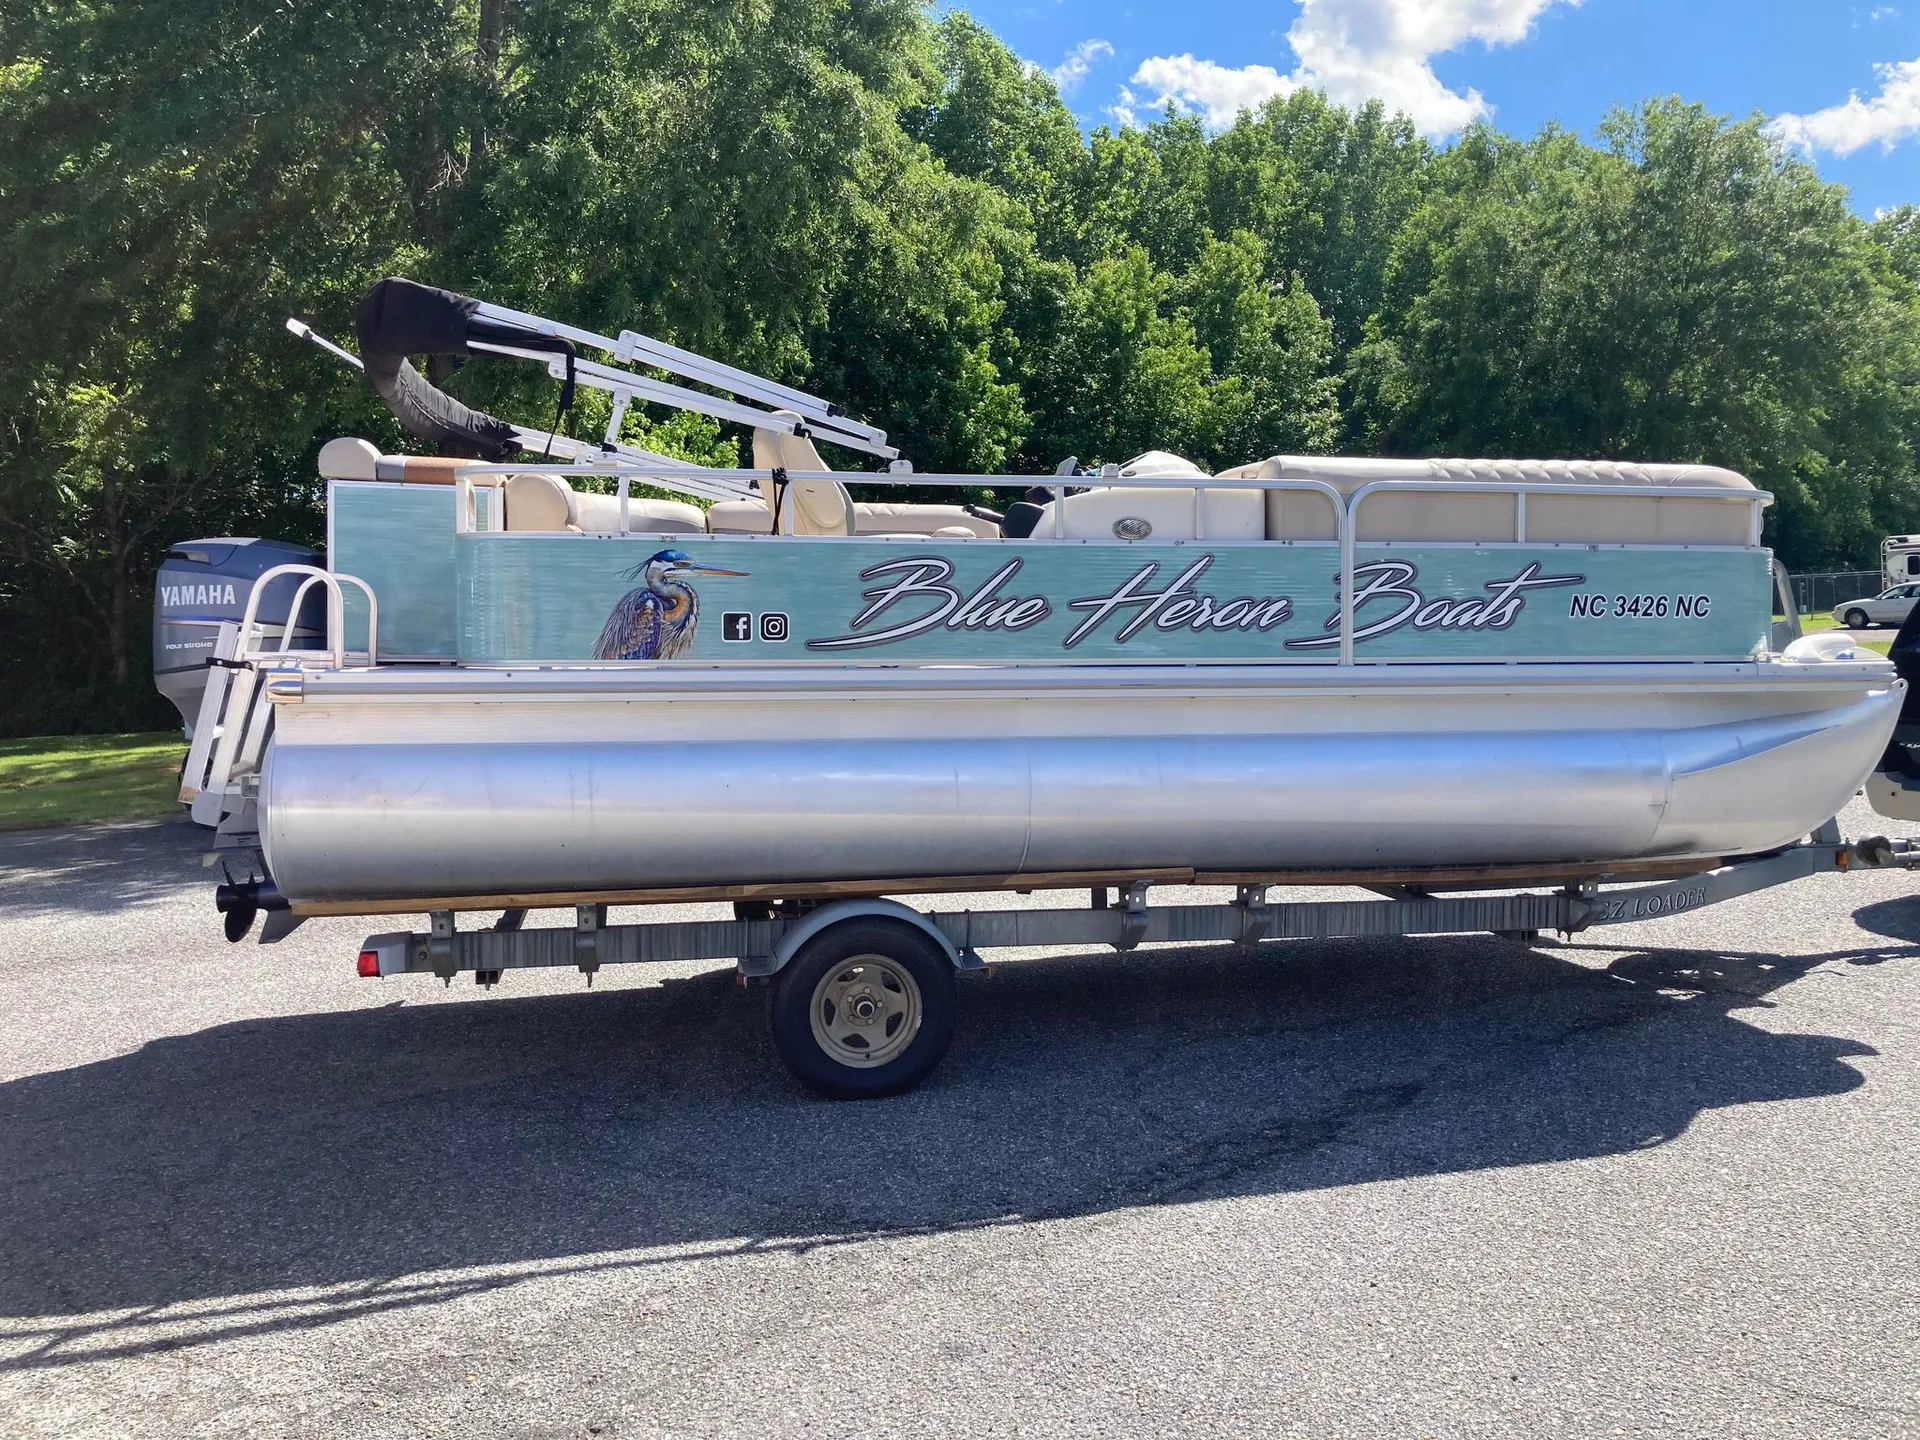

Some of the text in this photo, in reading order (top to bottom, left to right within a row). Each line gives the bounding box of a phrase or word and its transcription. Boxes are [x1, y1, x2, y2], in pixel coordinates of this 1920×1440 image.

[161, 584, 236, 607] YAMAHA
[805, 552, 1586, 651] Blue Heron Boats
[1569, 593, 1711, 619] NC 3426 NC
[1632, 886, 1706, 917] LOADER
